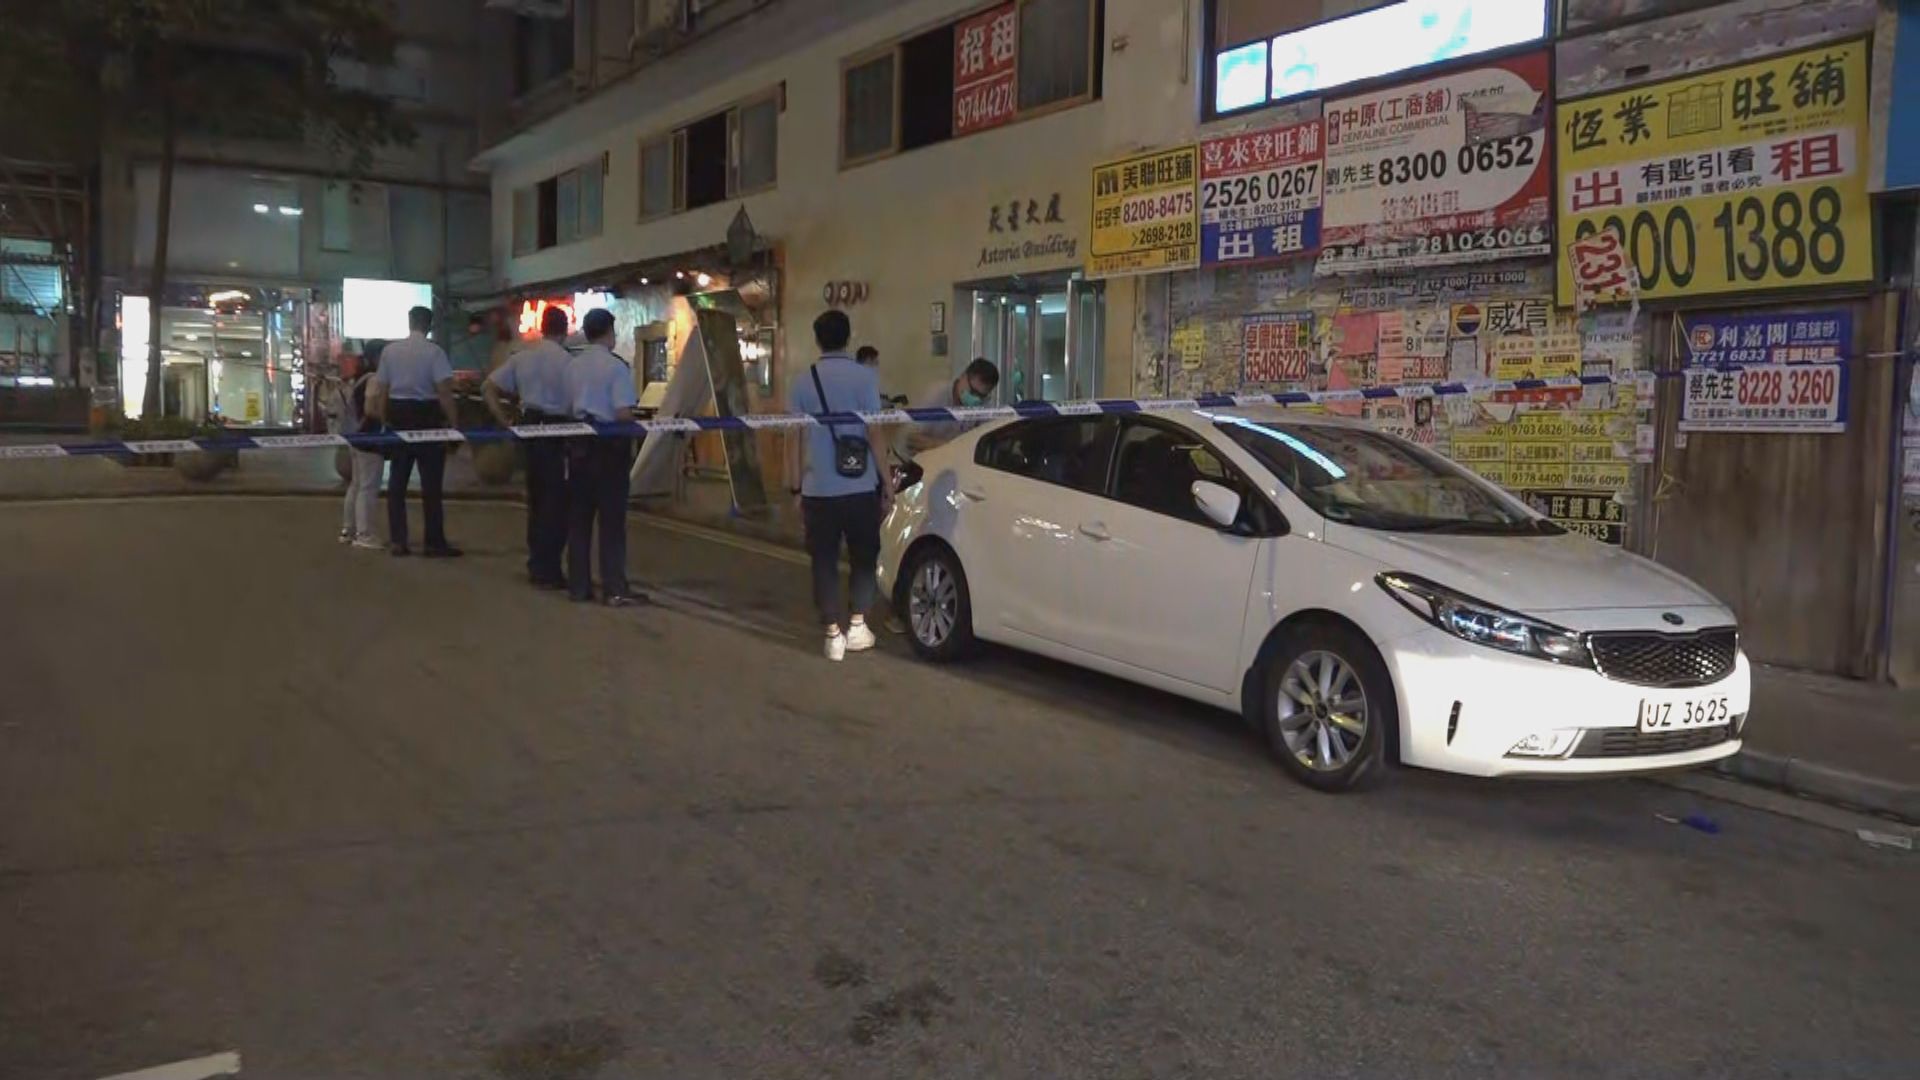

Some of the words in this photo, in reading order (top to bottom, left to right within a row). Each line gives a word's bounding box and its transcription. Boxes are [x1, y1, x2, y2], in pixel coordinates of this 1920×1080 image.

[1389, 115, 1450, 136] COMMERCIAL
[1377, 149, 1447, 187] 8300
[1457, 134, 1535, 176] 0652
[1572, 170, 1623, 212] 出
[1770, 133, 1844, 182] 租
[1641, 146, 1756, 188] 有匙引看
[1203, 174, 1262, 210] 2526
[1266, 163, 1319, 200] 0267
[1122, 191, 1194, 224] 8208-8475
[977, 246, 1020, 269] Astoria
[1022, 233, 1077, 260] Building
[1139, 221, 1193, 245] 2698-2128
[1218, 224, 1304, 262] 出租
[1482, 224, 1546, 250] 6066
[1713, 185, 1846, 282] 1388
[1485, 299, 1548, 332] 威信
[1245, 350, 1309, 381] 55486228
[1738, 370, 1783, 405] 8228
[1787, 369, 1835, 405] 3260
[1646, 702, 1673, 728] UZ
[1682, 697, 1729, 724] 3625
